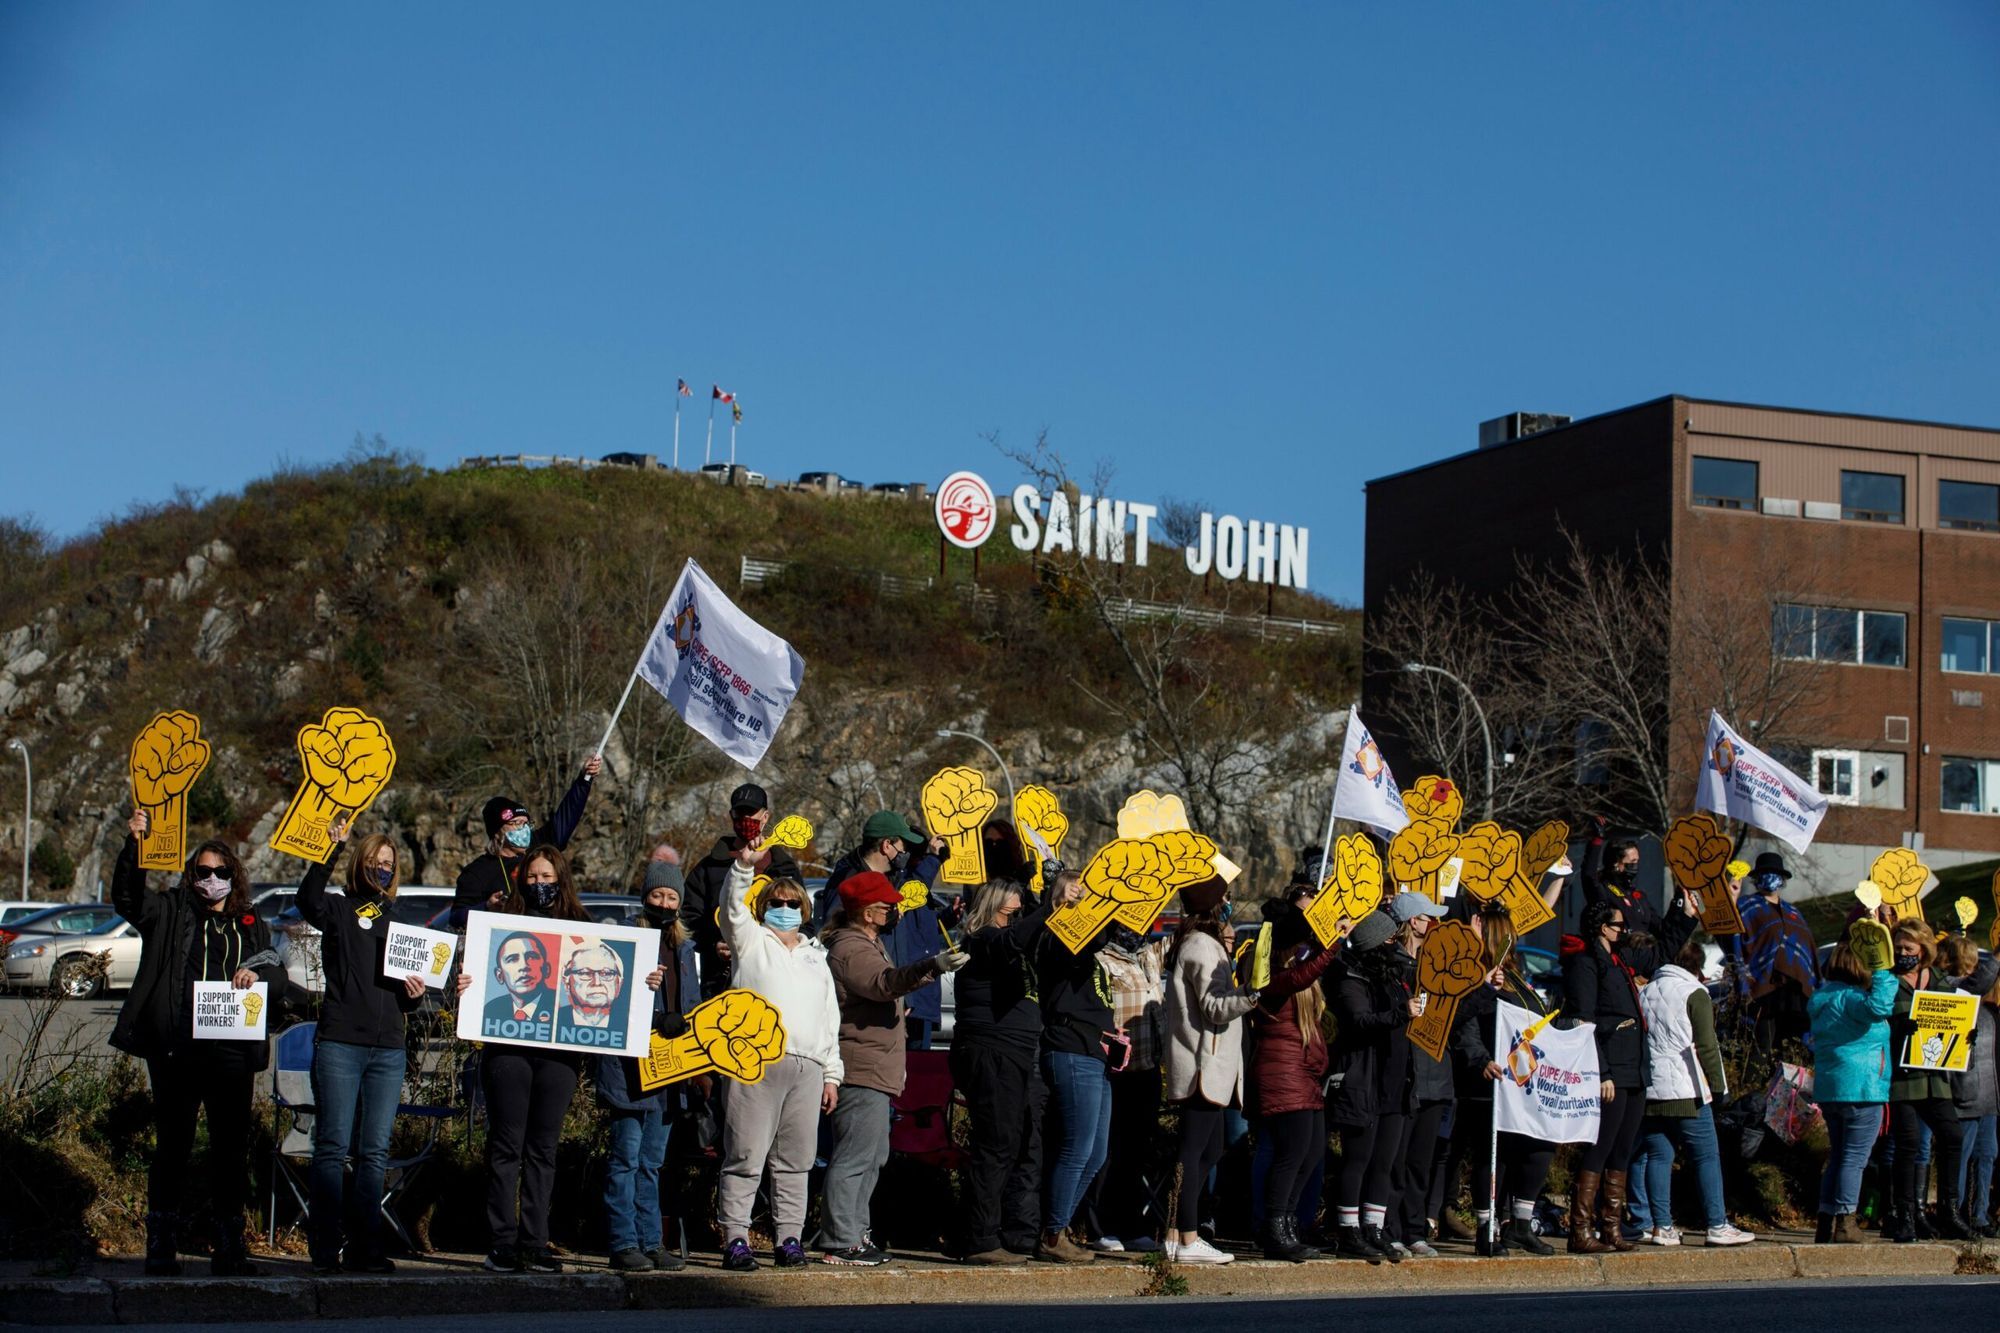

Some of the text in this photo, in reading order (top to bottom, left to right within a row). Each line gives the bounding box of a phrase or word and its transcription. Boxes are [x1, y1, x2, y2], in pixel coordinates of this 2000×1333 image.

[1010, 484, 1309, 589] SAINT JOHN
[730, 673, 752, 696] 1866
[746, 715, 763, 732] NB
[1735, 759, 1780, 787] CUPE/SCFP
[1797, 815, 1808, 826] NB
[300, 822, 322, 842] NB
[157, 835, 174, 851] NB
[957, 857, 974, 870] NB
[1068, 913, 1088, 931] NB
[390, 933, 427, 949] I SUPPORT
[388, 944, 429, 962] FRONT-LINE
[387, 955, 423, 972] WORKERS!
[197, 992, 236, 1003] I SUPPORT
[1918, 1001, 1957, 1009] BARGAINING
[197, 1004, 240, 1015] FRONT-LINE
[197, 1016, 235, 1027] WORKERS!
[484, 1017, 624, 1048] HOPE NOPE
[655, 1049, 671, 1070] NB
